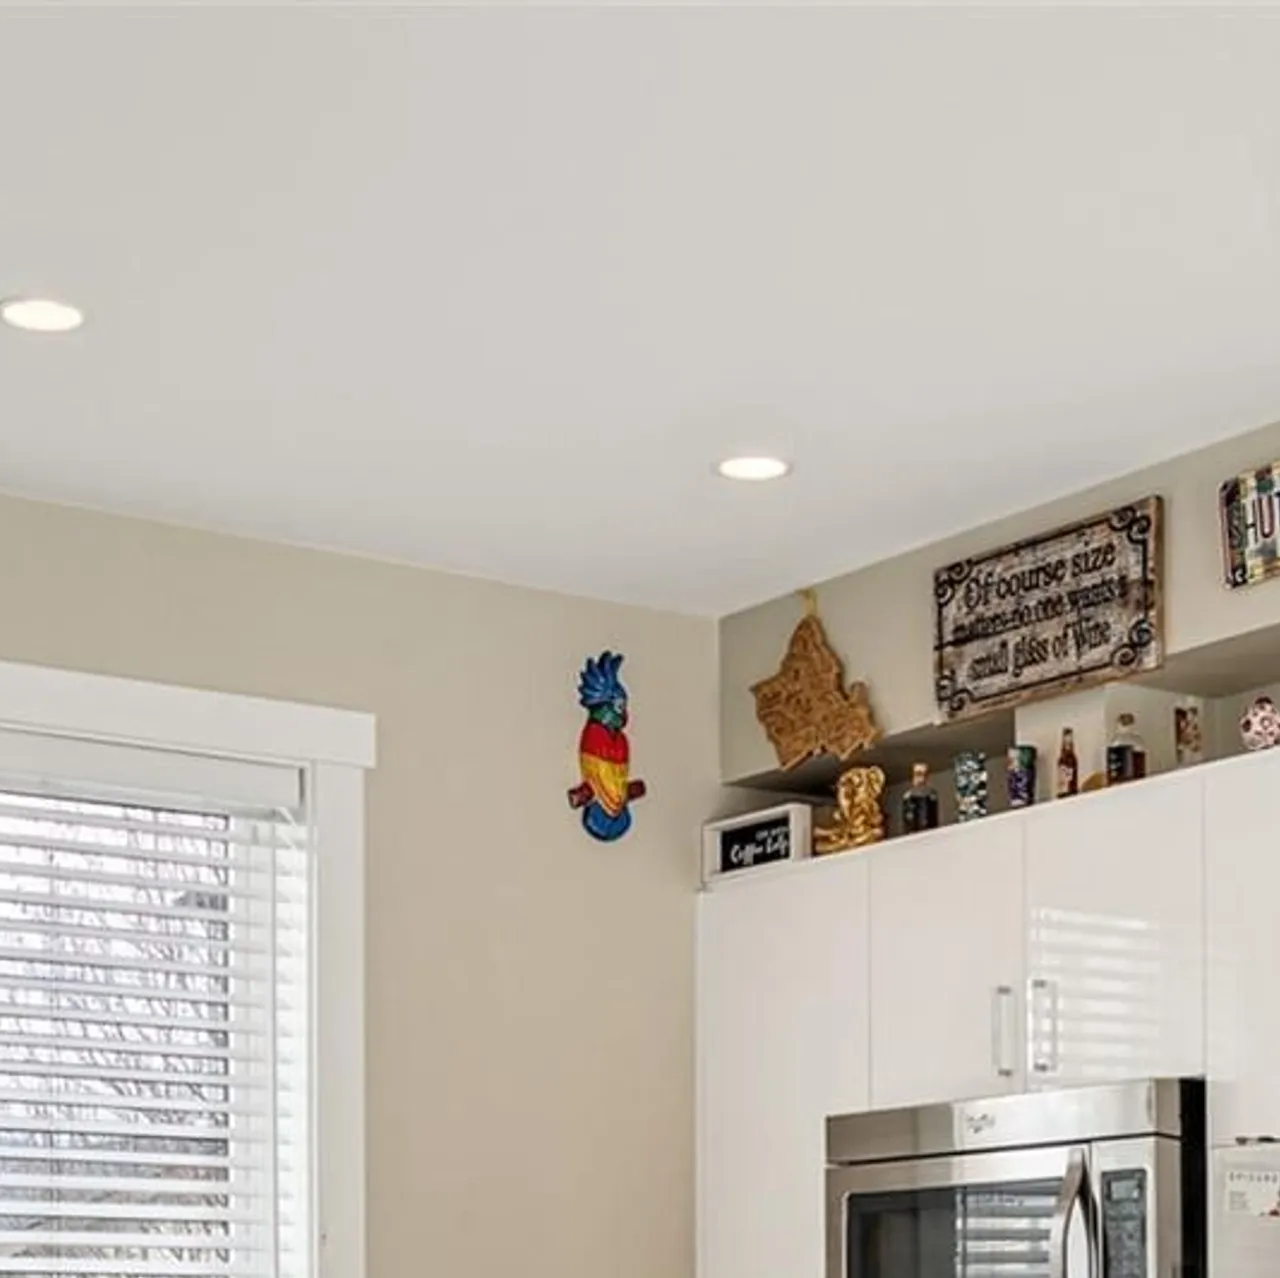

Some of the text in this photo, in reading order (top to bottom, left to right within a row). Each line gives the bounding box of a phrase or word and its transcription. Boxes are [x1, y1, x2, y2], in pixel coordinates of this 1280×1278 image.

[964, 540, 1117, 612] Of course size
[970, 639, 1009, 681] small
[1012, 634, 1050, 678] glass
[1051, 622, 1072, 658] of
